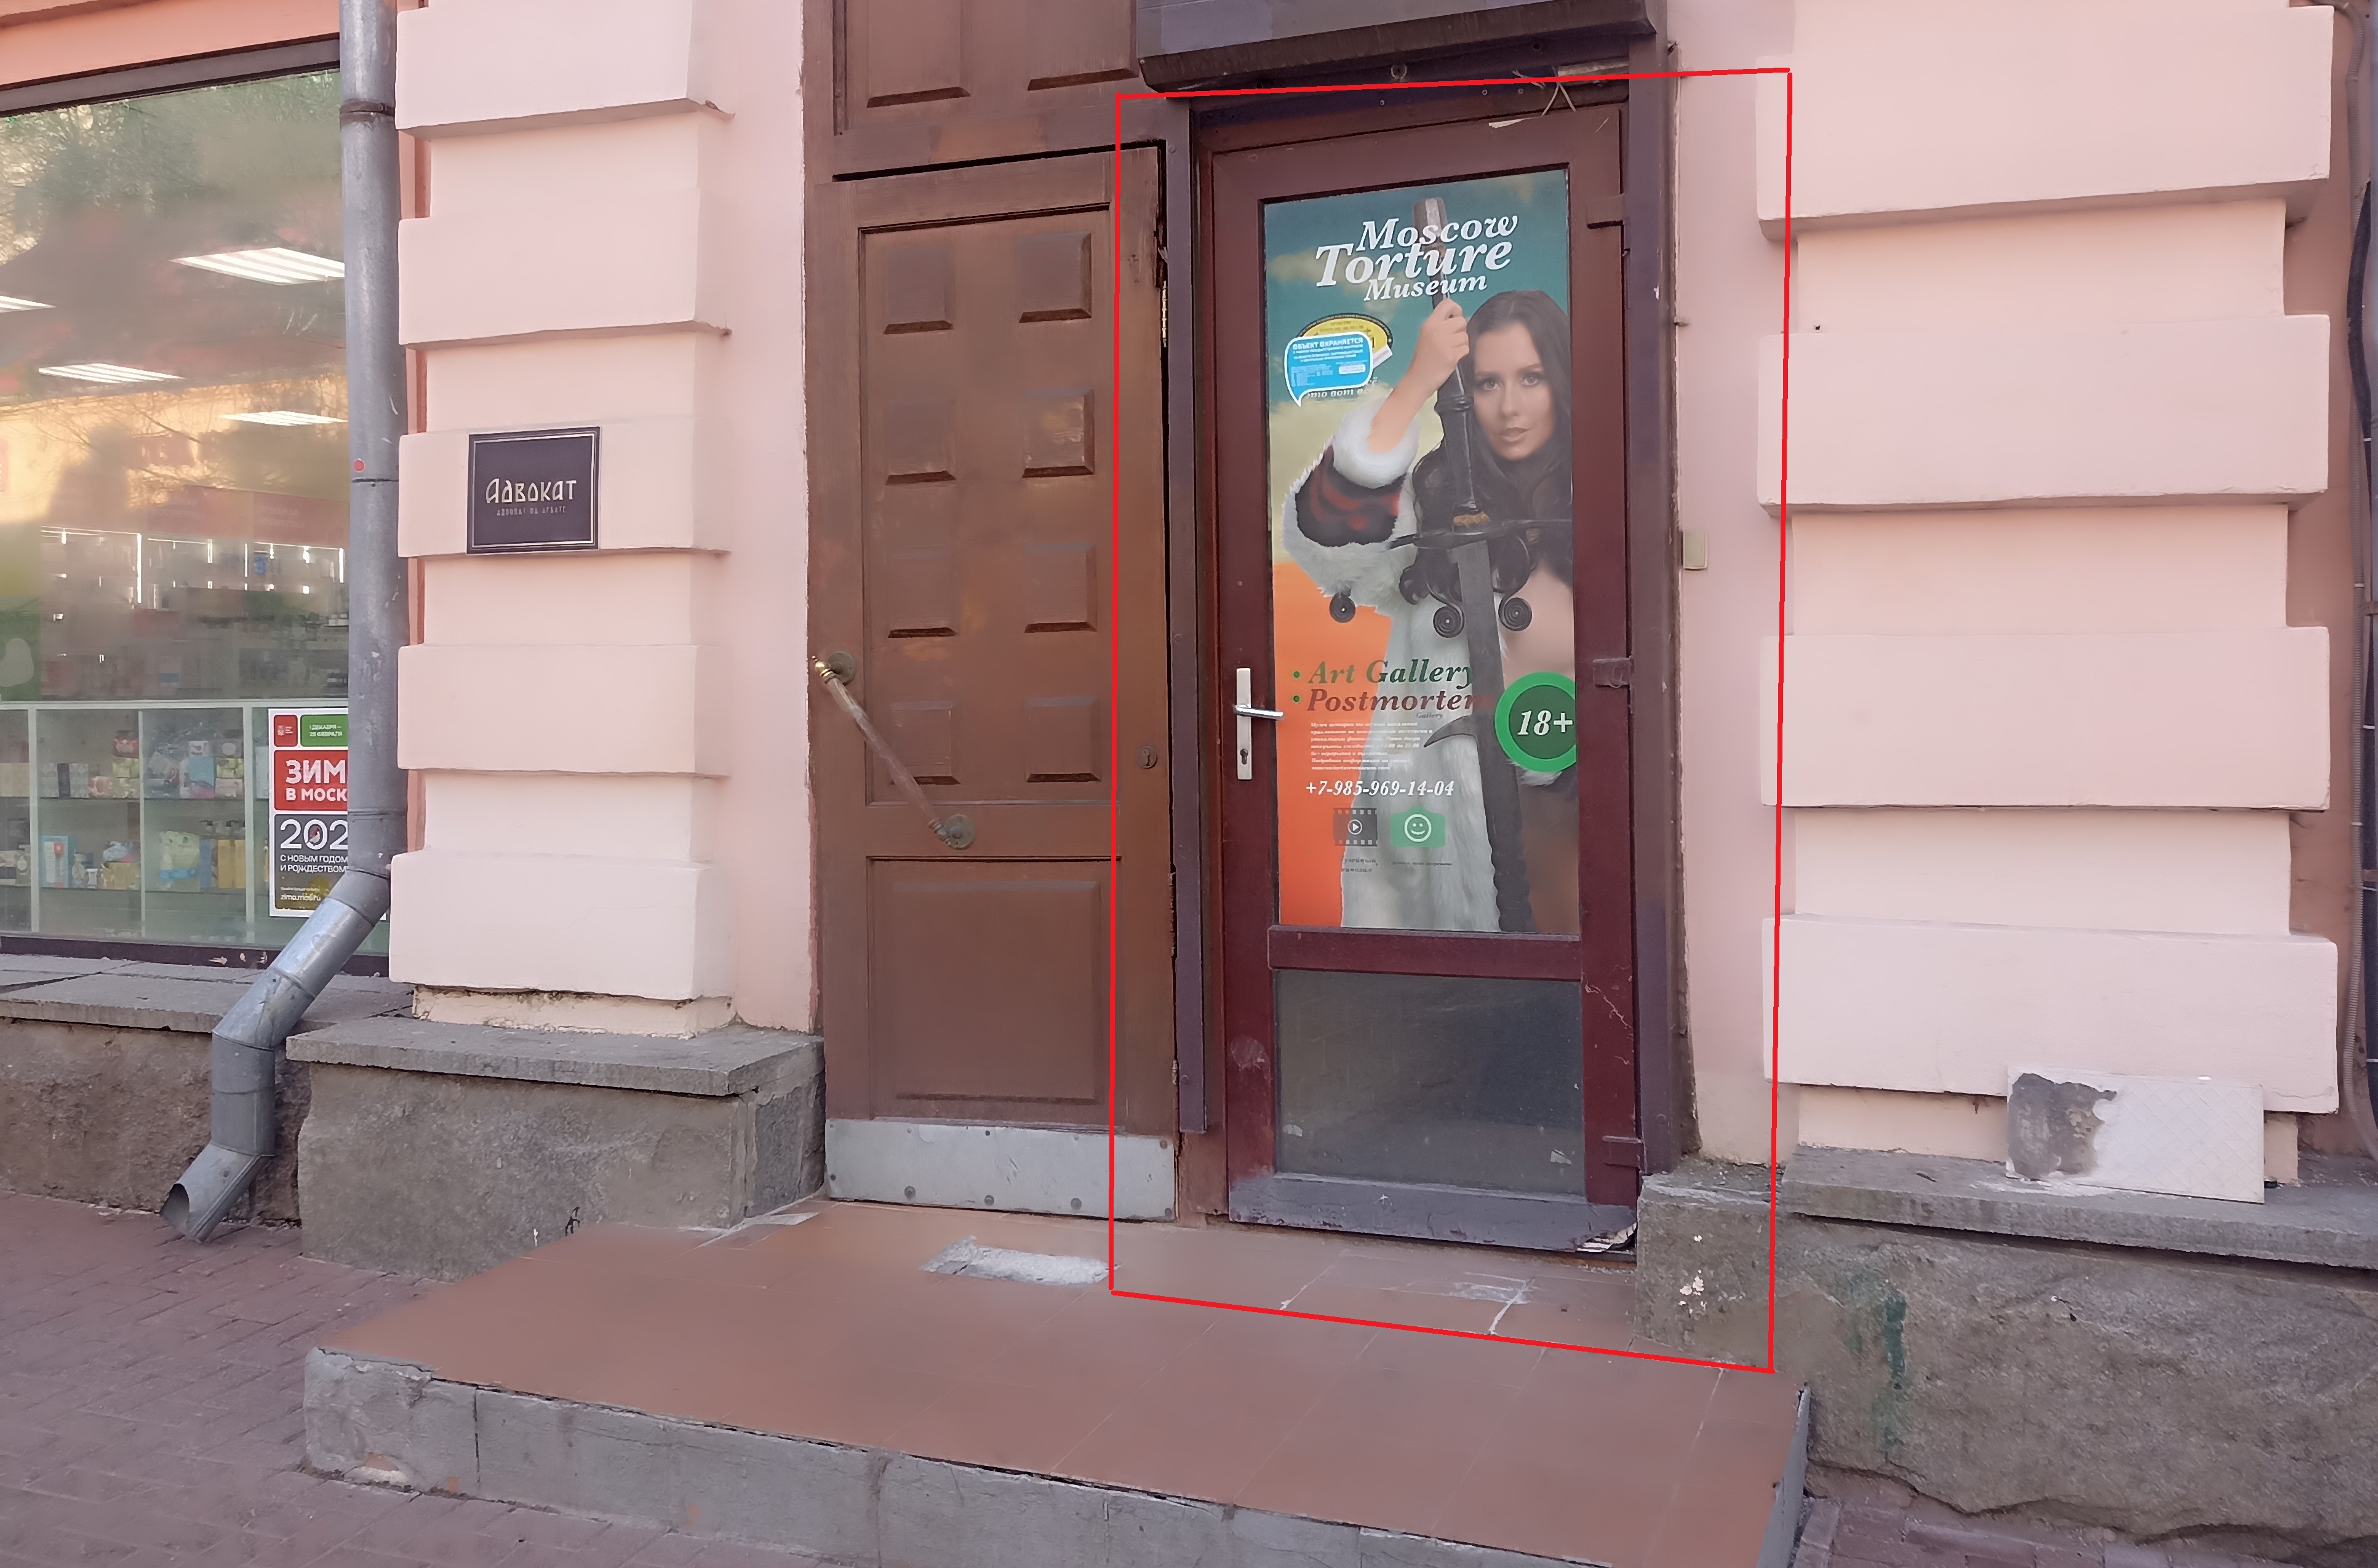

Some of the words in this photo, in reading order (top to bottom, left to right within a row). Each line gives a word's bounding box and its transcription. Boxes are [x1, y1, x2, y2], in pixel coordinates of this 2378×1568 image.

[1356, 215, 1518, 252] Moscow
[1315, 241, 1513, 287] Torture
[1364, 276, 1487, 301] Museum
[1319, 337, 1363, 348] ОХРАНЯЕТСЯ
[1307, 661, 1356, 684] Art
[1366, 659, 1473, 690] Gallery
[1518, 710, 1574, 736] 18+
[285, 759, 346, 784] ЗИМ
[285, 787, 296, 801] В
[301, 787, 348, 802] МОСК
[1306, 781, 1454, 796] +7-985-969-14-04
[280, 819, 348, 850] 202
[287, 864, 346, 873] РОЖДЕСТВОМ
